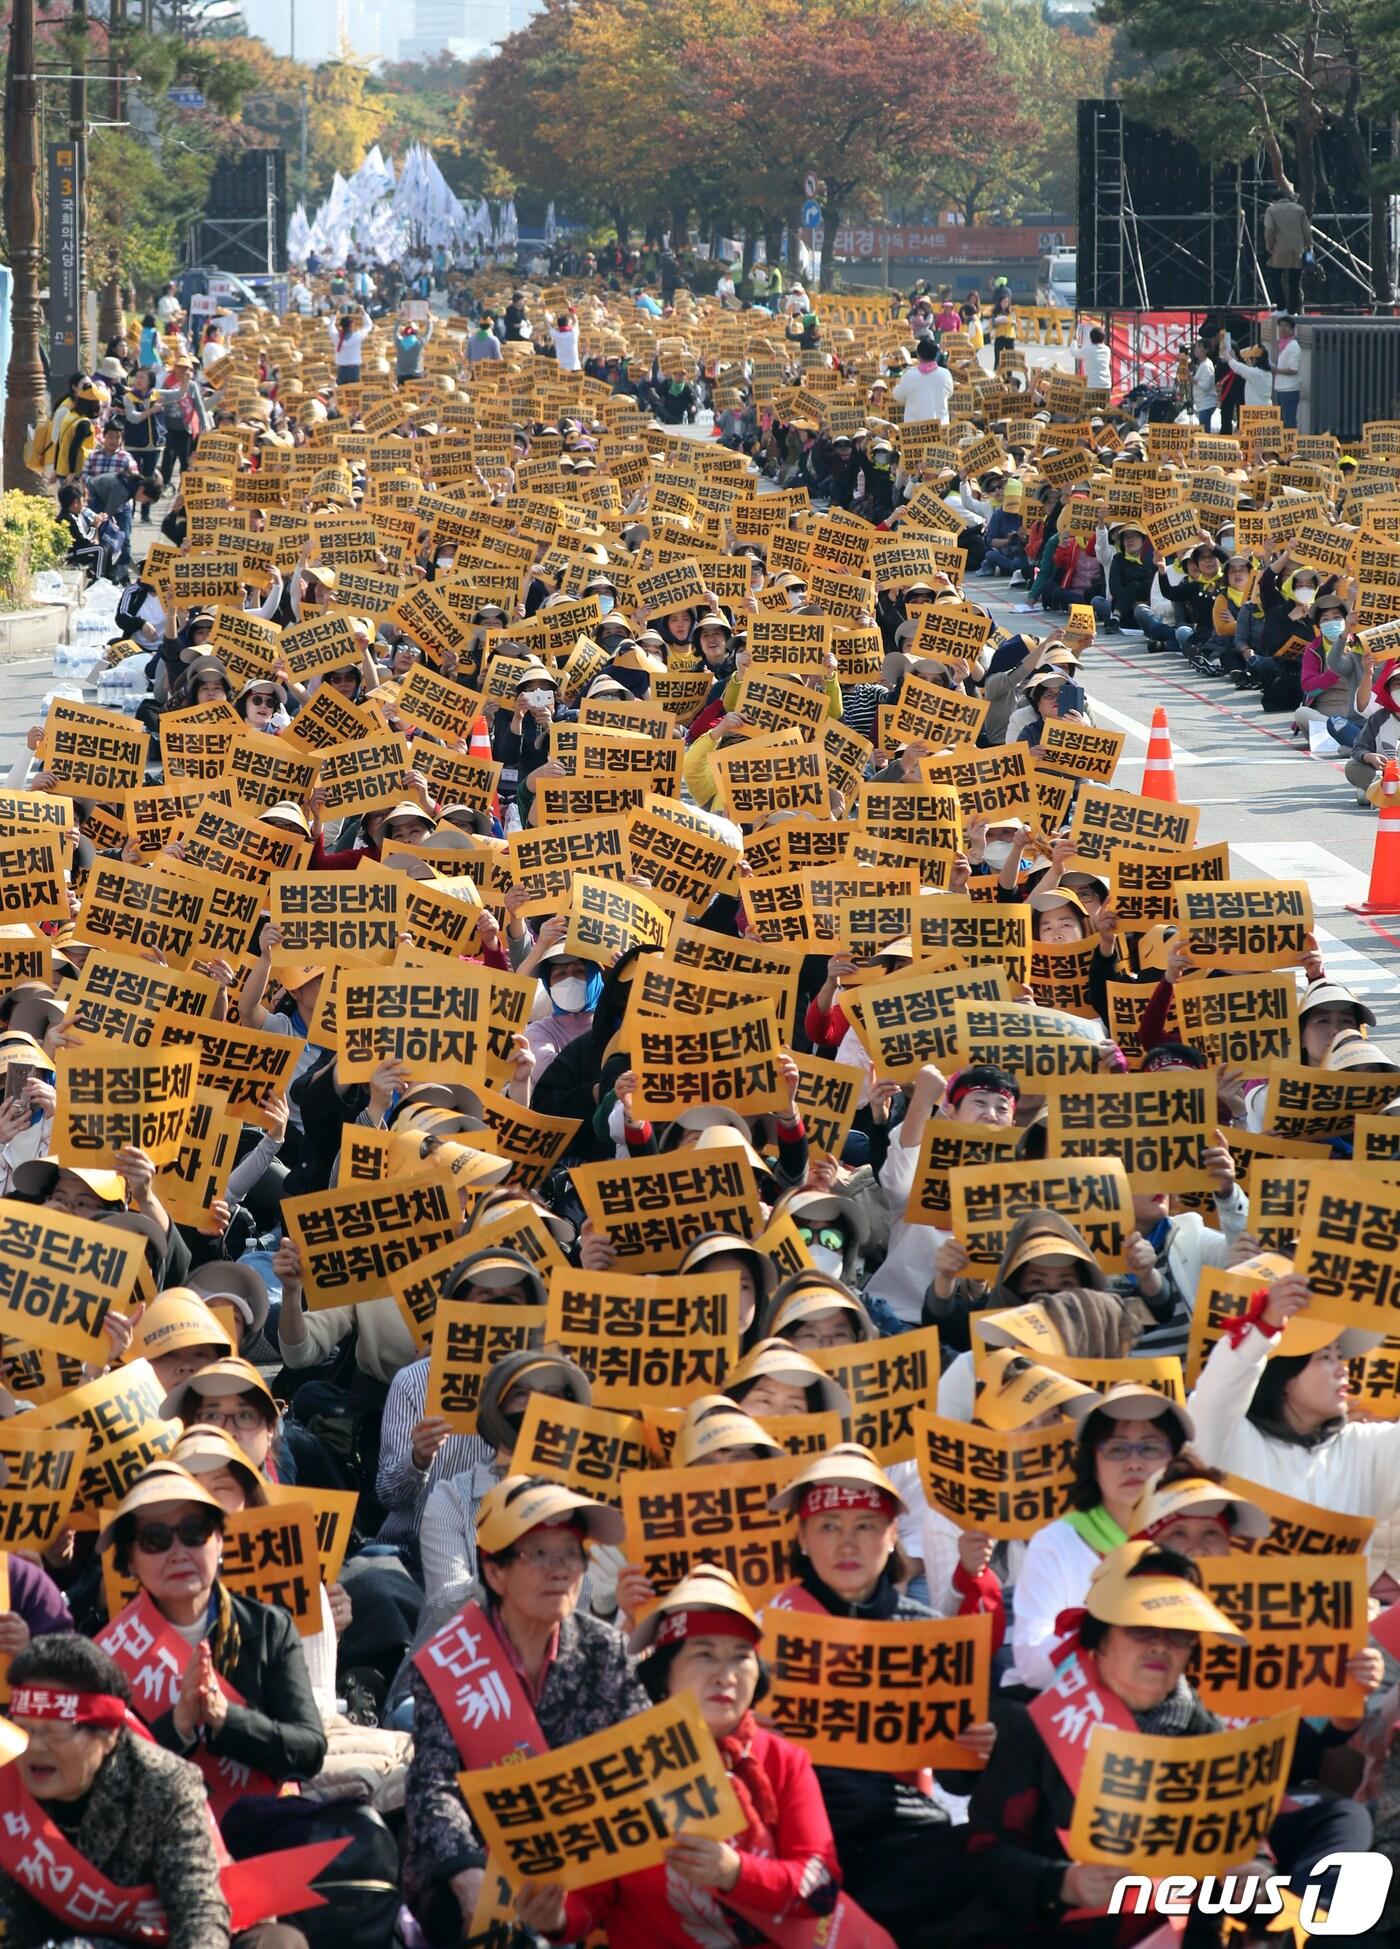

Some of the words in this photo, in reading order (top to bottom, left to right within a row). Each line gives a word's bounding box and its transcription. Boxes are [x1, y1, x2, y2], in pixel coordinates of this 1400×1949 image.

[61, 178, 73, 195] 3
[61, 199, 74, 268] 국회의사당
[908, 233, 946, 249] 콘서트
[830, 410, 864, 421] 법정단체
[1242, 409, 1278, 419] 법정단체
[473, 433, 512, 444] 법정단체
[901, 422, 940, 436] 법정단체
[1151, 429, 1188, 438] 법정단체
[295, 452, 338, 464] 법정단체
[369, 448, 412, 459] 법정단체
[960, 438, 996, 464] 법정단체
[1151, 440, 1187, 451] 쟁취하자
[1197, 440, 1238, 450] 법정단체
[1199, 451, 1239, 462] 쟁취하자
[1297, 440, 1334, 448] 법정단체
[430, 452, 472, 465] 법정단체
[432, 465, 472, 478] 쟁취하자
[517, 461, 558, 477] 법정단체
[609, 457, 649, 476] 법정단체
[964, 451, 1001, 474] 쟁취하자
[1042, 453, 1084, 473] 법정단체
[235, 476, 280, 490] 법정단체
[711, 477, 755, 490] 법정단체
[1050, 467, 1089, 485] 쟁취하자
[1115, 467, 1157, 480] 법정단체
[1192, 477, 1236, 496] 법정단체
[1270, 472, 1313, 487] 법정단체
[235, 490, 281, 504] 쟁취하자
[532, 481, 577, 495] 법정단체
[1351, 482, 1395, 498] 법정단체
[191, 516, 245, 530] 법정단체
[735, 507, 786, 520] 법정단체
[915, 493, 965, 533] 법정단체
[1147, 509, 1194, 536] 법정단체
[1267, 507, 1320, 530] 법정단체
[218, 533, 274, 556] 법정단체
[320, 531, 376, 547] 법정단체
[482, 535, 532, 561] 법정단체
[819, 528, 869, 551] 법정단체
[1154, 526, 1199, 550] 쟁취하자
[1300, 526, 1353, 551] 법정단체
[320, 548, 377, 566] 쟁취하자
[812, 542, 864, 569] 쟁취하자
[872, 542, 930, 565] 법정단체
[1295, 539, 1347, 569] 쟁취하자
[174, 561, 238, 577] 법정단체
[637, 565, 698, 594] 법정단체
[875, 564, 933, 582] 쟁취하자
[174, 581, 239, 598] 쟁취하자
[338, 571, 399, 597] 법정단체
[643, 582, 703, 611] 쟁취하자
[809, 577, 865, 602] 법정단체
[336, 590, 396, 615] 쟁취하자
[541, 604, 599, 628] 법정단체
[219, 613, 276, 642] 법정단체
[397, 601, 443, 657] 쟁취하자
[411, 589, 465, 648] 법정단체
[753, 622, 824, 642] 법정단체
[925, 610, 989, 642] 법정단체
[280, 618, 349, 652] 법정단체
[550, 621, 601, 648] 쟁취하자
[919, 634, 979, 662] 쟁취하자
[215, 646, 277, 683] 법정단체
[287, 639, 356, 674] 쟁취하자
[752, 645, 824, 664] 쟁취하자
[412, 673, 478, 718] 법정단체
[655, 681, 706, 697] 법정단체
[748, 681, 822, 722] 법정단체
[316, 694, 369, 741] 법정단체
[400, 701, 468, 738] 쟁취하자
[905, 685, 980, 728] 법정단체
[898, 711, 972, 745] 쟁취하자
[1046, 726, 1118, 756] 법정단체
[55, 730, 141, 765] 법정단체
[584, 745, 677, 773] 법정단체
[50, 758, 138, 790] 쟁취하자
[231, 747, 314, 788] 법정단체
[320, 744, 402, 781] 법정단체
[412, 750, 493, 793] 법정단체
[728, 753, 820, 784] 법정단체
[929, 754, 1025, 786] 법정단체
[1044, 750, 1112, 775] 쟁취하자
[325, 769, 409, 808] 쟁취하자
[544, 789, 645, 814] 법정단체
[731, 784, 824, 811] 쟁취하자
[959, 783, 1031, 815] 취하자
[867, 795, 956, 823] 법정단체
[1083, 798, 1190, 845] 법정단체
[195, 811, 294, 869] 법정단체
[517, 830, 621, 870] 법정단체
[628, 820, 728, 881] 법정단체
[1118, 857, 1225, 890] 법정단체
[96, 871, 205, 925] 법정단체
[280, 884, 397, 914] 법정단체
[1186, 890, 1304, 918] 법정단체
[583, 884, 665, 945] 법정단체
[87, 905, 194, 956] 쟁취하자
[280, 920, 398, 950] 쟁취하자
[920, 917, 1025, 948] 법정단체
[1188, 924, 1306, 954] 쟁취하자
[88, 964, 207, 1017] 법정단체
[346, 984, 480, 1022] 법정단체
[1182, 988, 1287, 1029] 법정단체
[346, 1026, 478, 1066] 쟁취하자
[641, 1017, 773, 1066] 법정단체
[68, 1062, 192, 1104] 법정단체
[641, 1059, 779, 1104] 쟁취하자
[1060, 1088, 1205, 1129] 법정단체
[68, 1107, 184, 1150] 쟁취하자
[598, 1162, 745, 1215] 법정단체
[962, 1173, 1121, 1223] 법정단체
[298, 1182, 452, 1249] 법정단체
[561, 1290, 728, 1338] 법정단체
[775, 1633, 974, 1690] 법정단체
[771, 1695, 975, 1745] 쟁취하자
[483, 1719, 703, 1830] 법정단체
[1101, 1734, 1283, 1804] 법정단체
[505, 1774, 720, 1877] 쟁취하자
[1089, 1795, 1275, 1857] 쟁취하자
